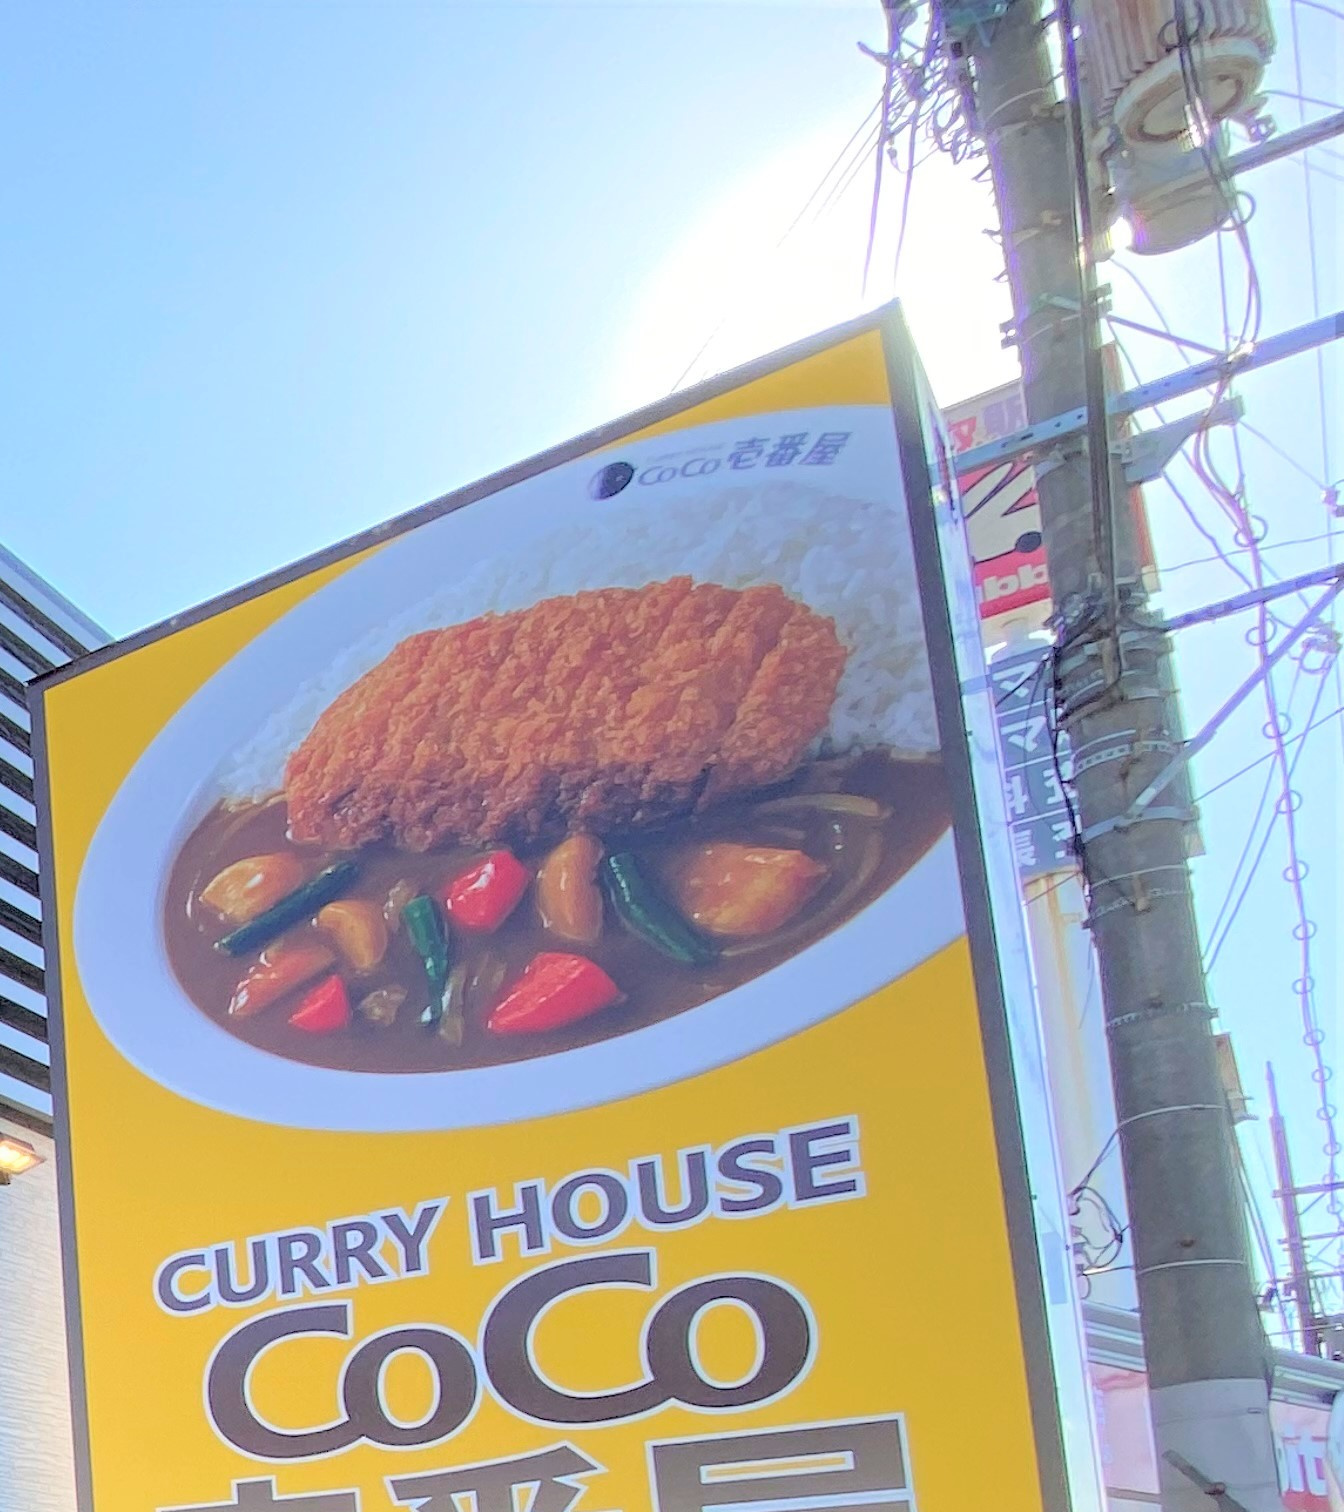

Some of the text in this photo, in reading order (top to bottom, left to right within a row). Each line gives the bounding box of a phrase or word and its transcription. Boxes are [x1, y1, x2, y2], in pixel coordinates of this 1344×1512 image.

[637, 430, 853, 487] CoCo壱番屋
[157, 1116, 864, 1315] CURRY HOUSE
[204, 1248, 818, 1462] CoCo
